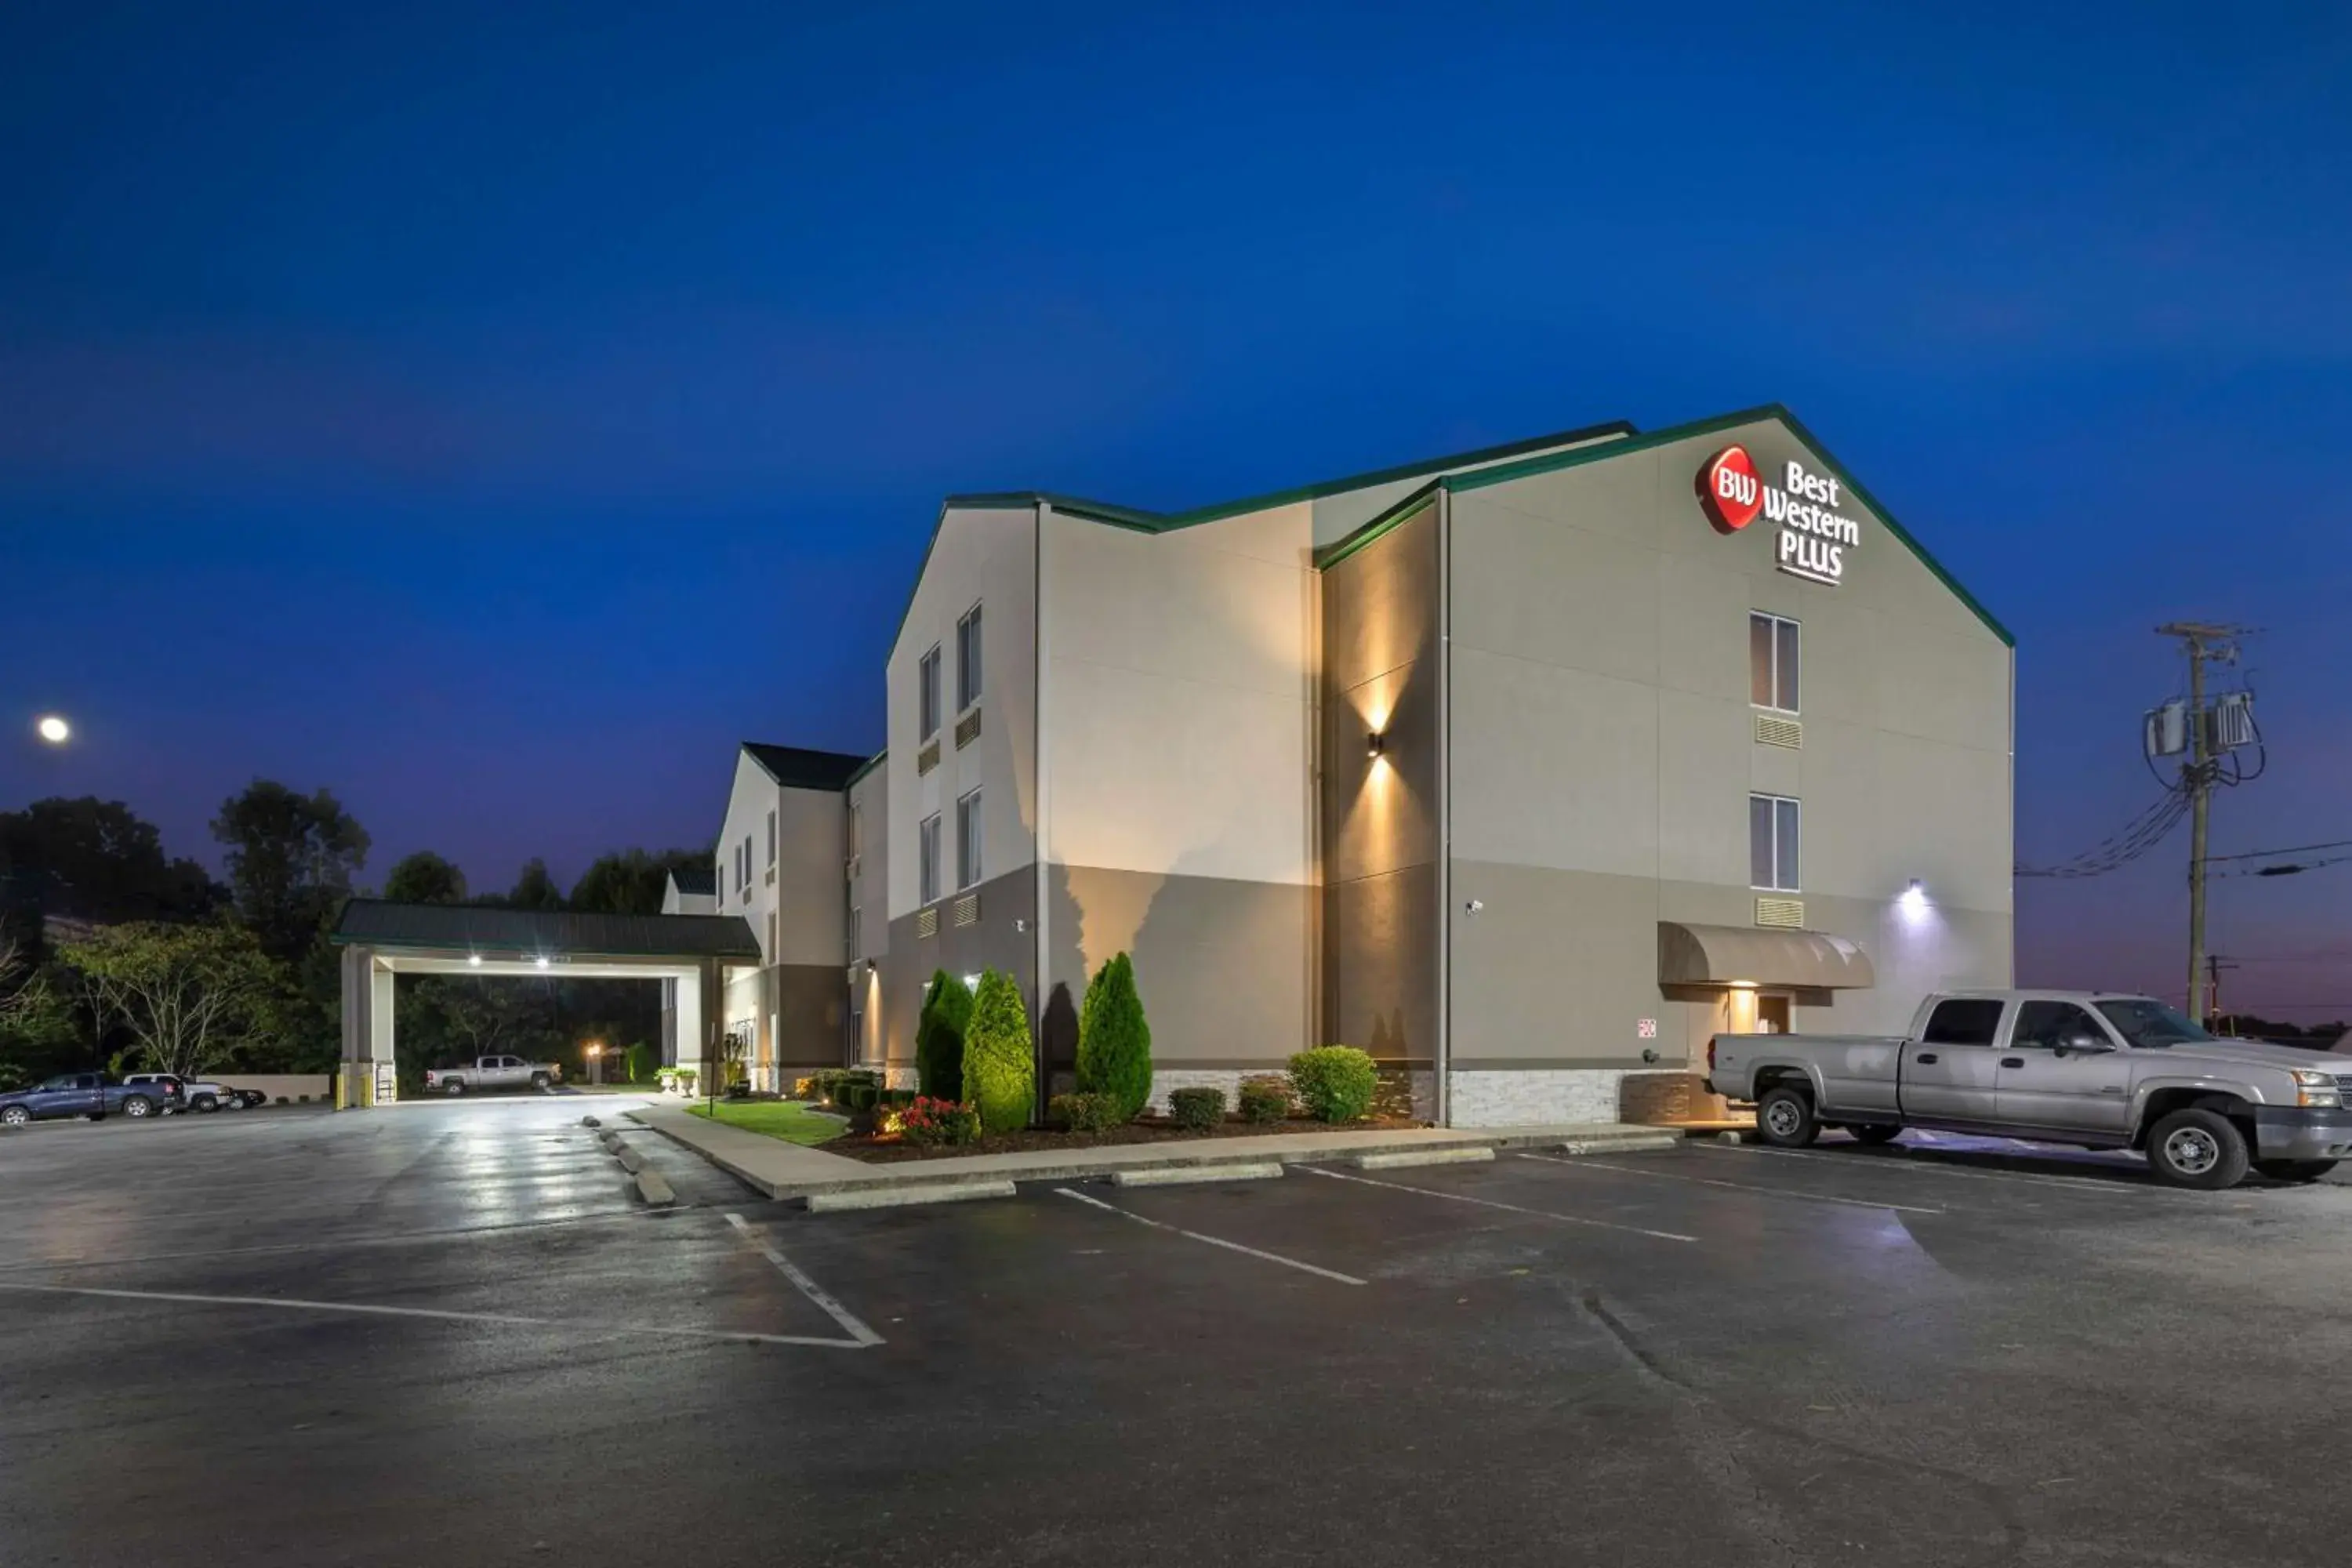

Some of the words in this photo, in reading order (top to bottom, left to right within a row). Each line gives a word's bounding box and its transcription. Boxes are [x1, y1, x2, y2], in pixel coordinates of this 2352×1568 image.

[1719, 466, 1756, 505] BW
[1787, 460, 1839, 507] Best
[1763, 485, 1859, 546] Western
[1780, 529, 1842, 577] PLUS
